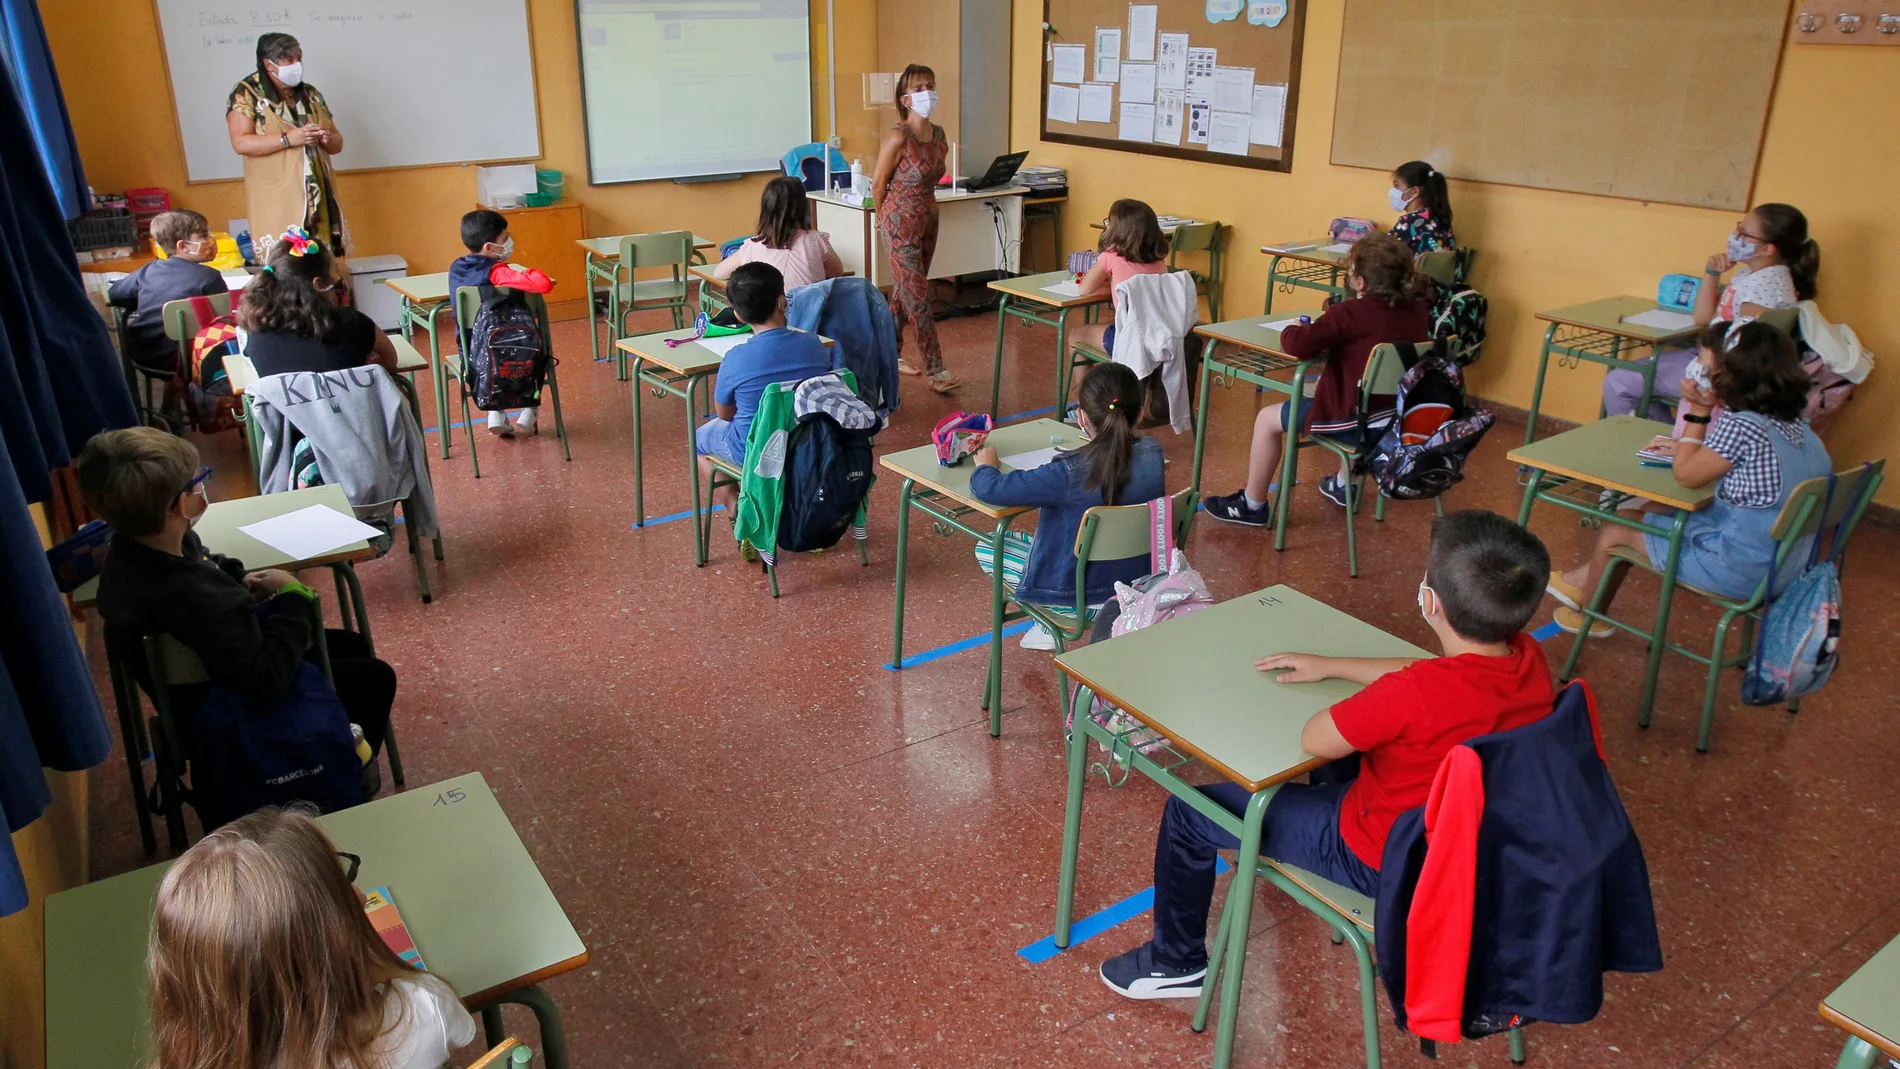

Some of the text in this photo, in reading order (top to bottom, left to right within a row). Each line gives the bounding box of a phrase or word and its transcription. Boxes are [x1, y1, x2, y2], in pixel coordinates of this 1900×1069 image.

[277, 366, 376, 407] KING
[1227, 506, 1242, 518] N
[1157, 523, 1165, 550] FOOTY
[1258, 596, 1284, 608] 14
[432, 787, 467, 807] 15
